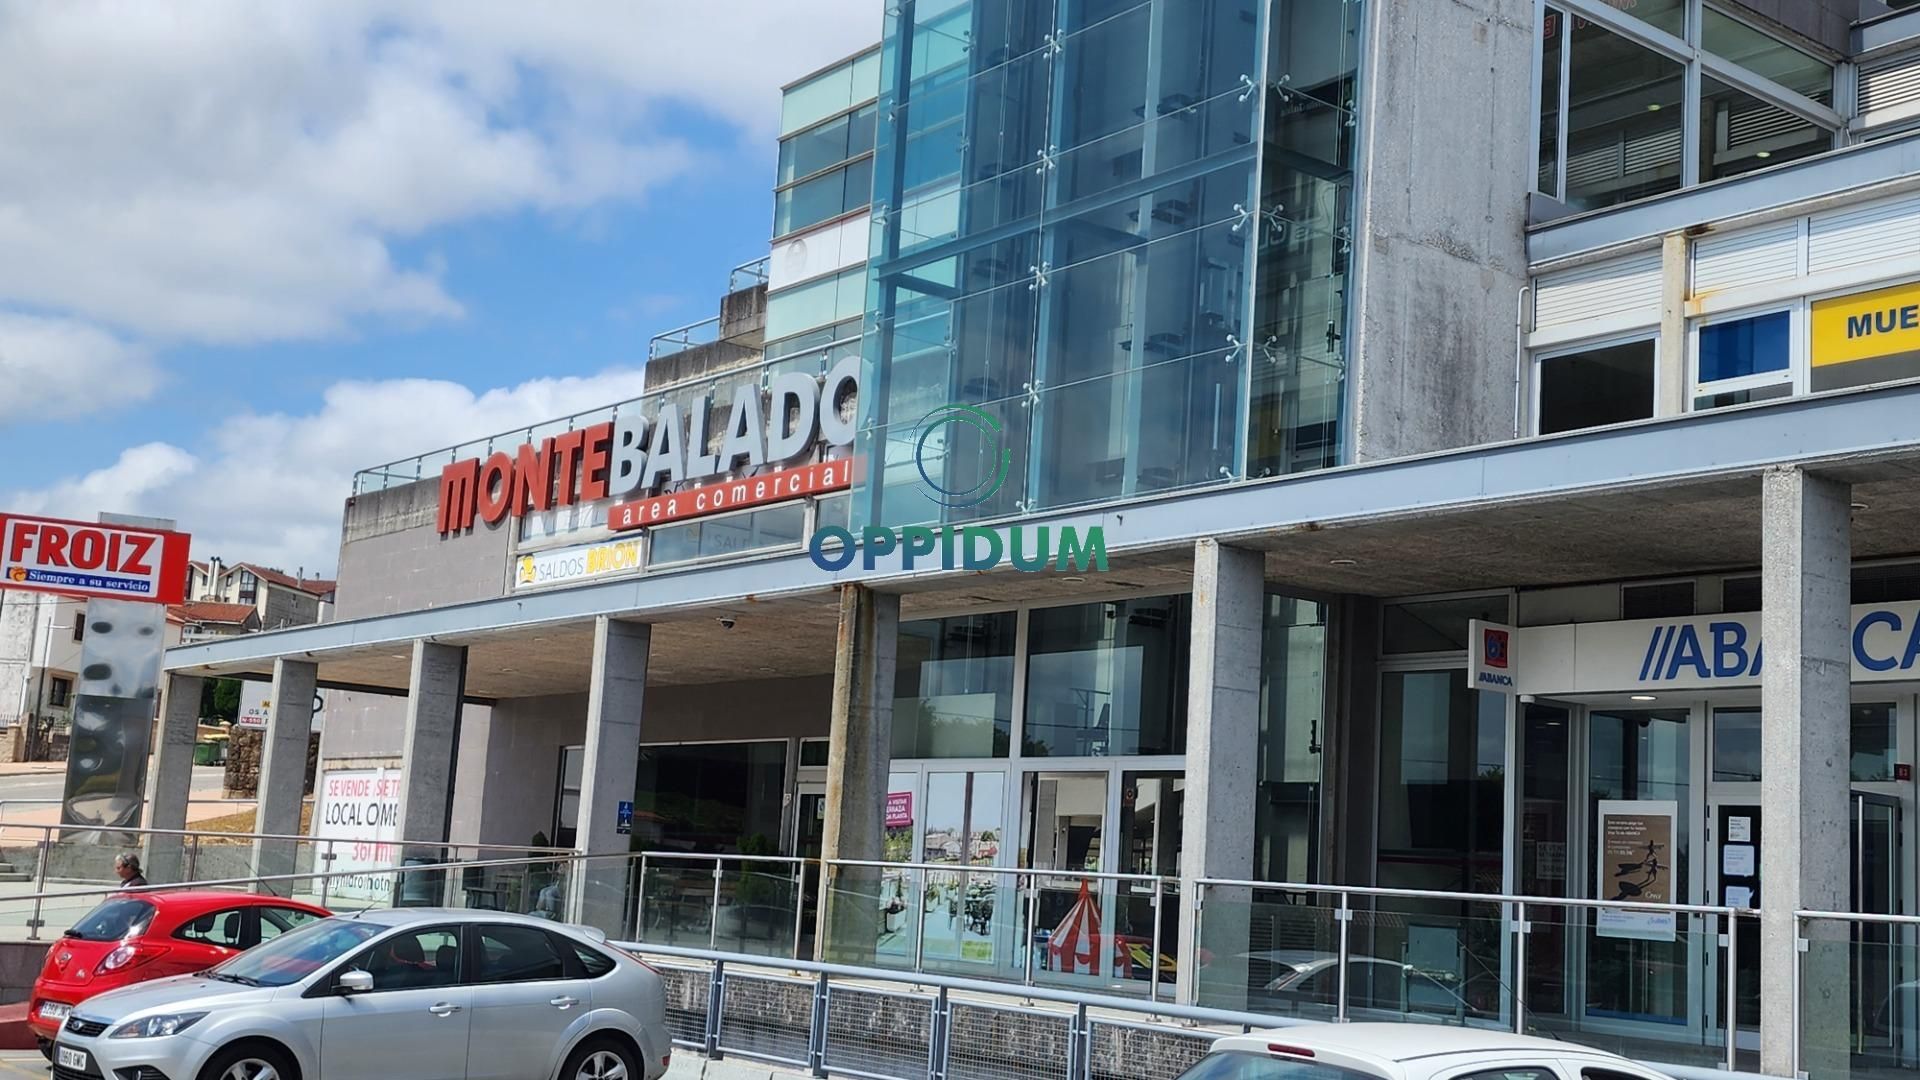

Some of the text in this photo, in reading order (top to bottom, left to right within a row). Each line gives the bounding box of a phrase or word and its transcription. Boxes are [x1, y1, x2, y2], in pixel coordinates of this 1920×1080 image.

[1848, 304, 1919, 339] MUE
[696, 461, 849, 510] comercial
[10, 522, 156, 576] FROIZ
[29, 570, 149, 592] Siempre a su servicio
[539, 557, 584, 581] SALDOS
[328, 779, 340, 797] SE
[341, 779, 370, 797] VENDE
[325, 802, 362, 826] LOCAL
